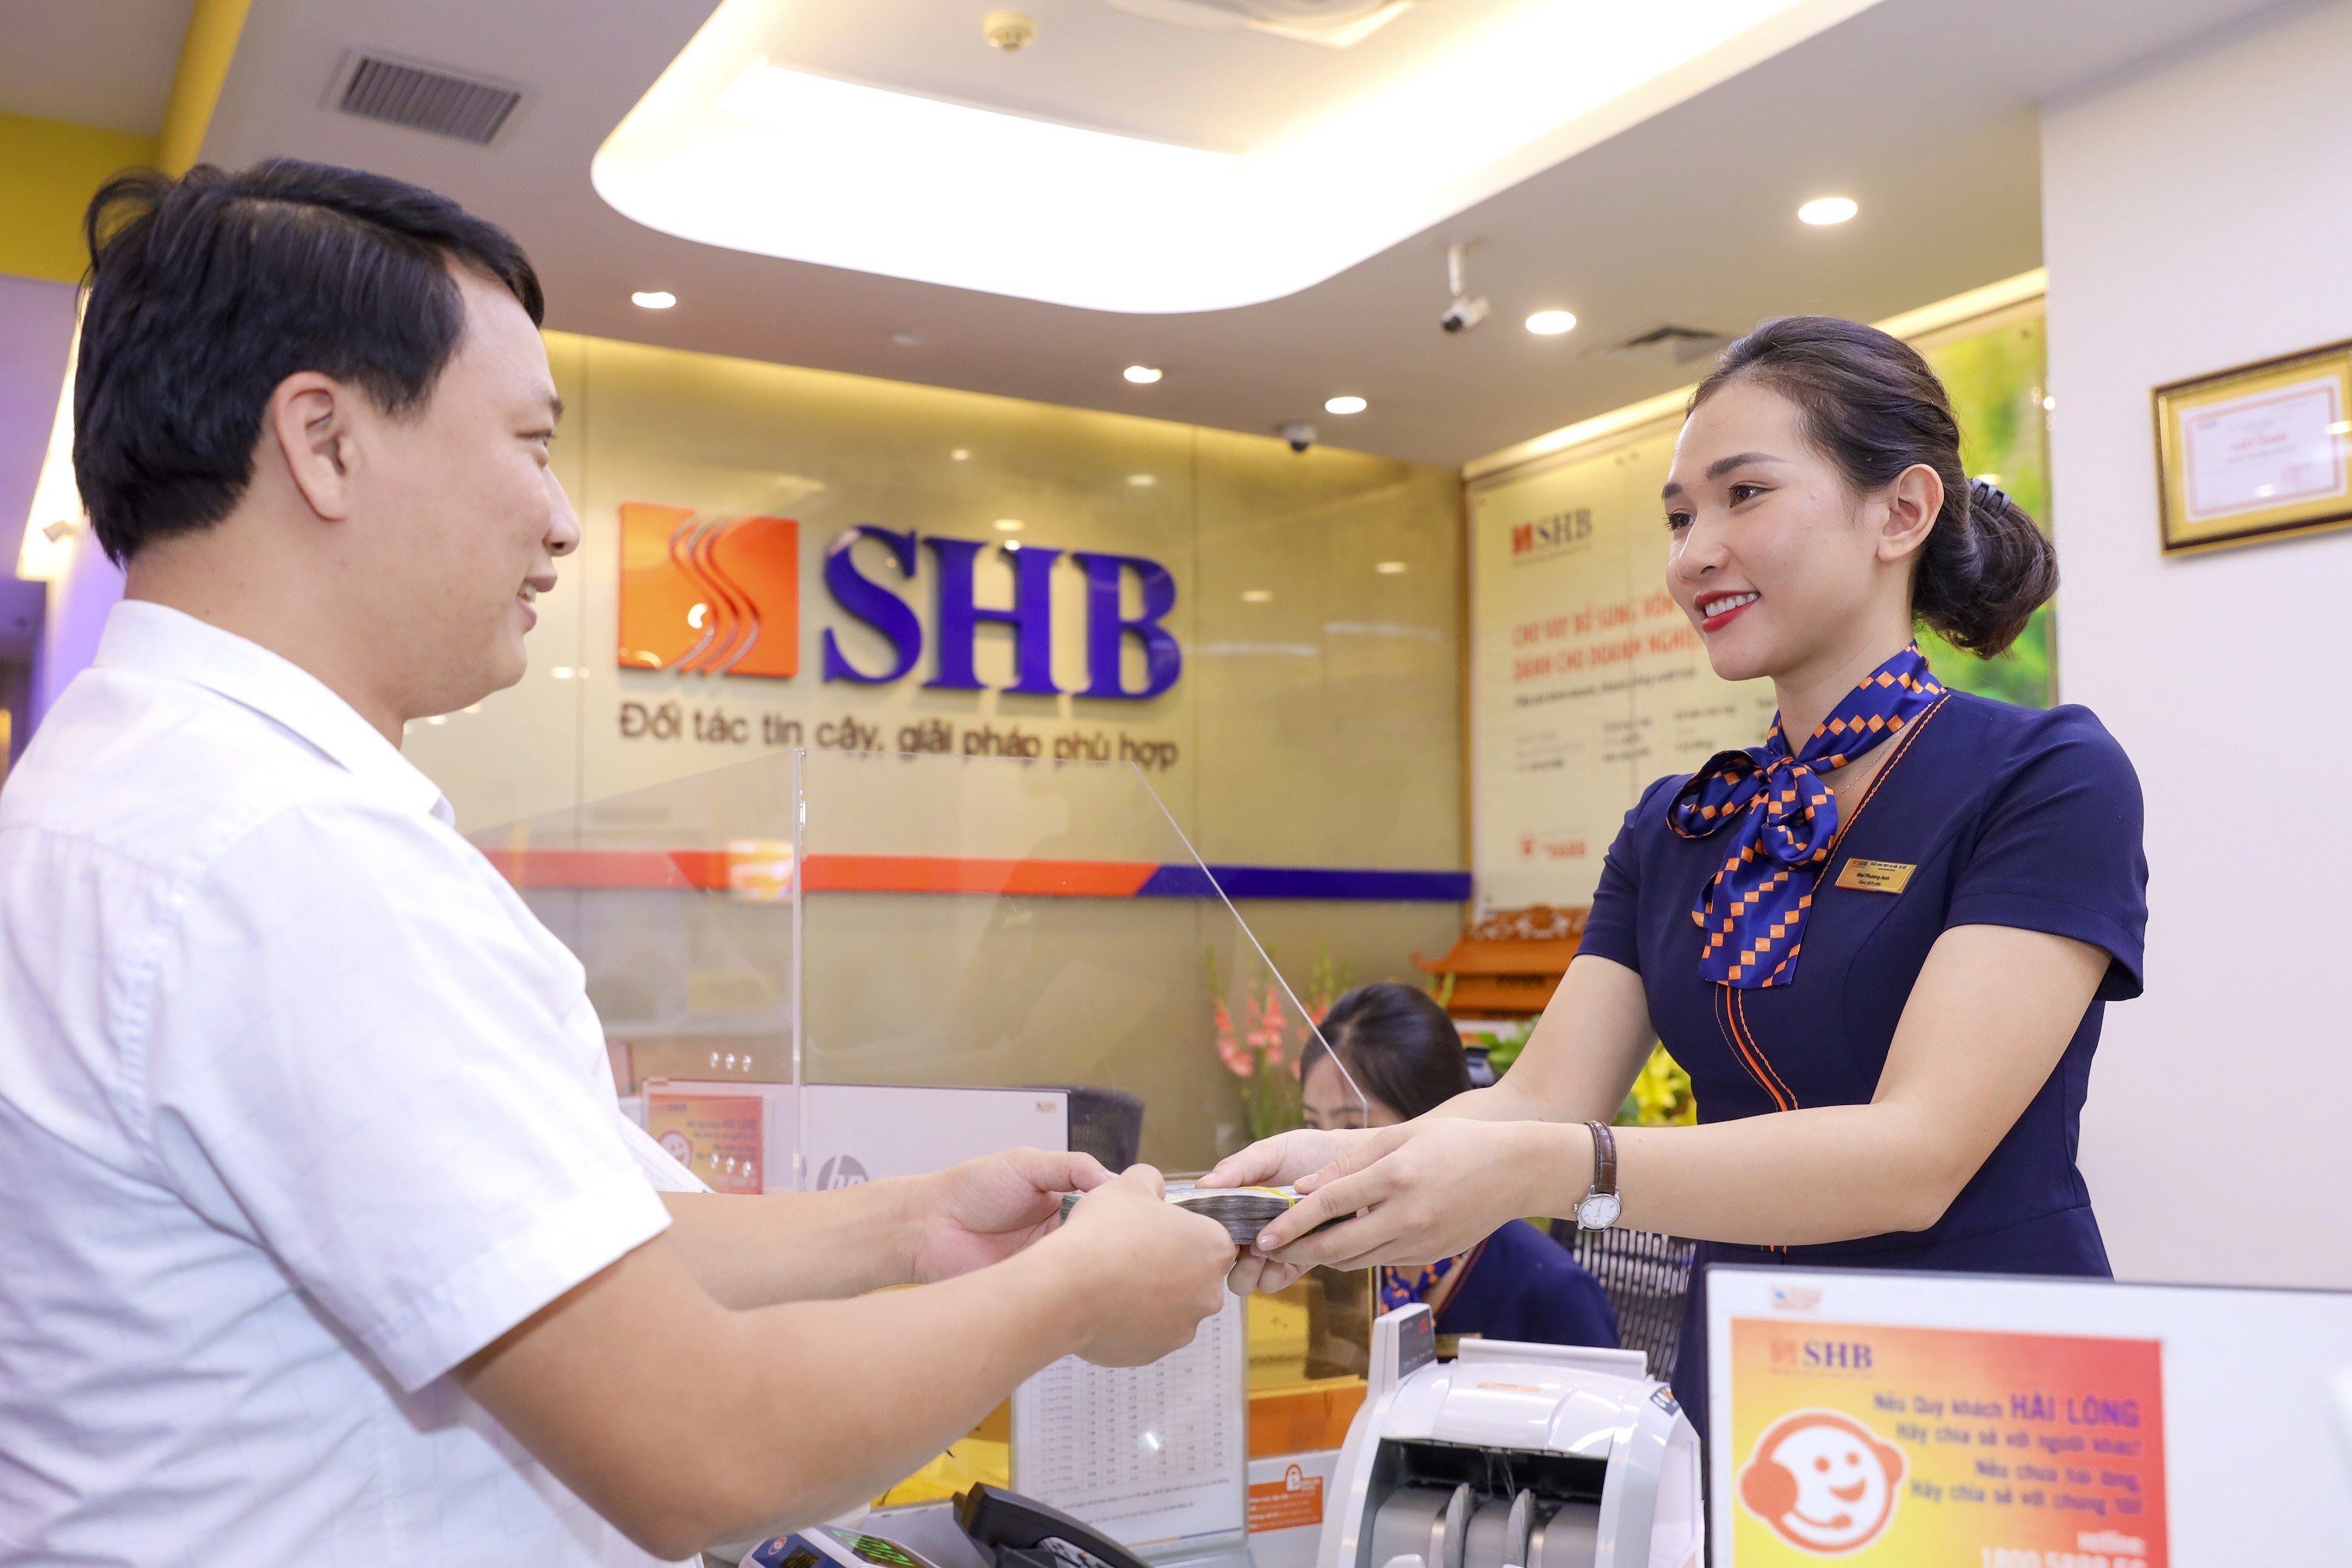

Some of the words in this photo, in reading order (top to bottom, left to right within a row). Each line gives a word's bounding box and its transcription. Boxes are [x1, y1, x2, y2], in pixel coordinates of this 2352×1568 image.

[1536, 507, 1593, 550] SHB
[822, 525, 1182, 702] SHB
[618, 701, 682, 740] Đối
[693, 706, 751, 746] tác
[898, 719, 954, 761] giải
[963, 724, 1041, 768] pháp
[1802, 1339, 1874, 1369] SHB
